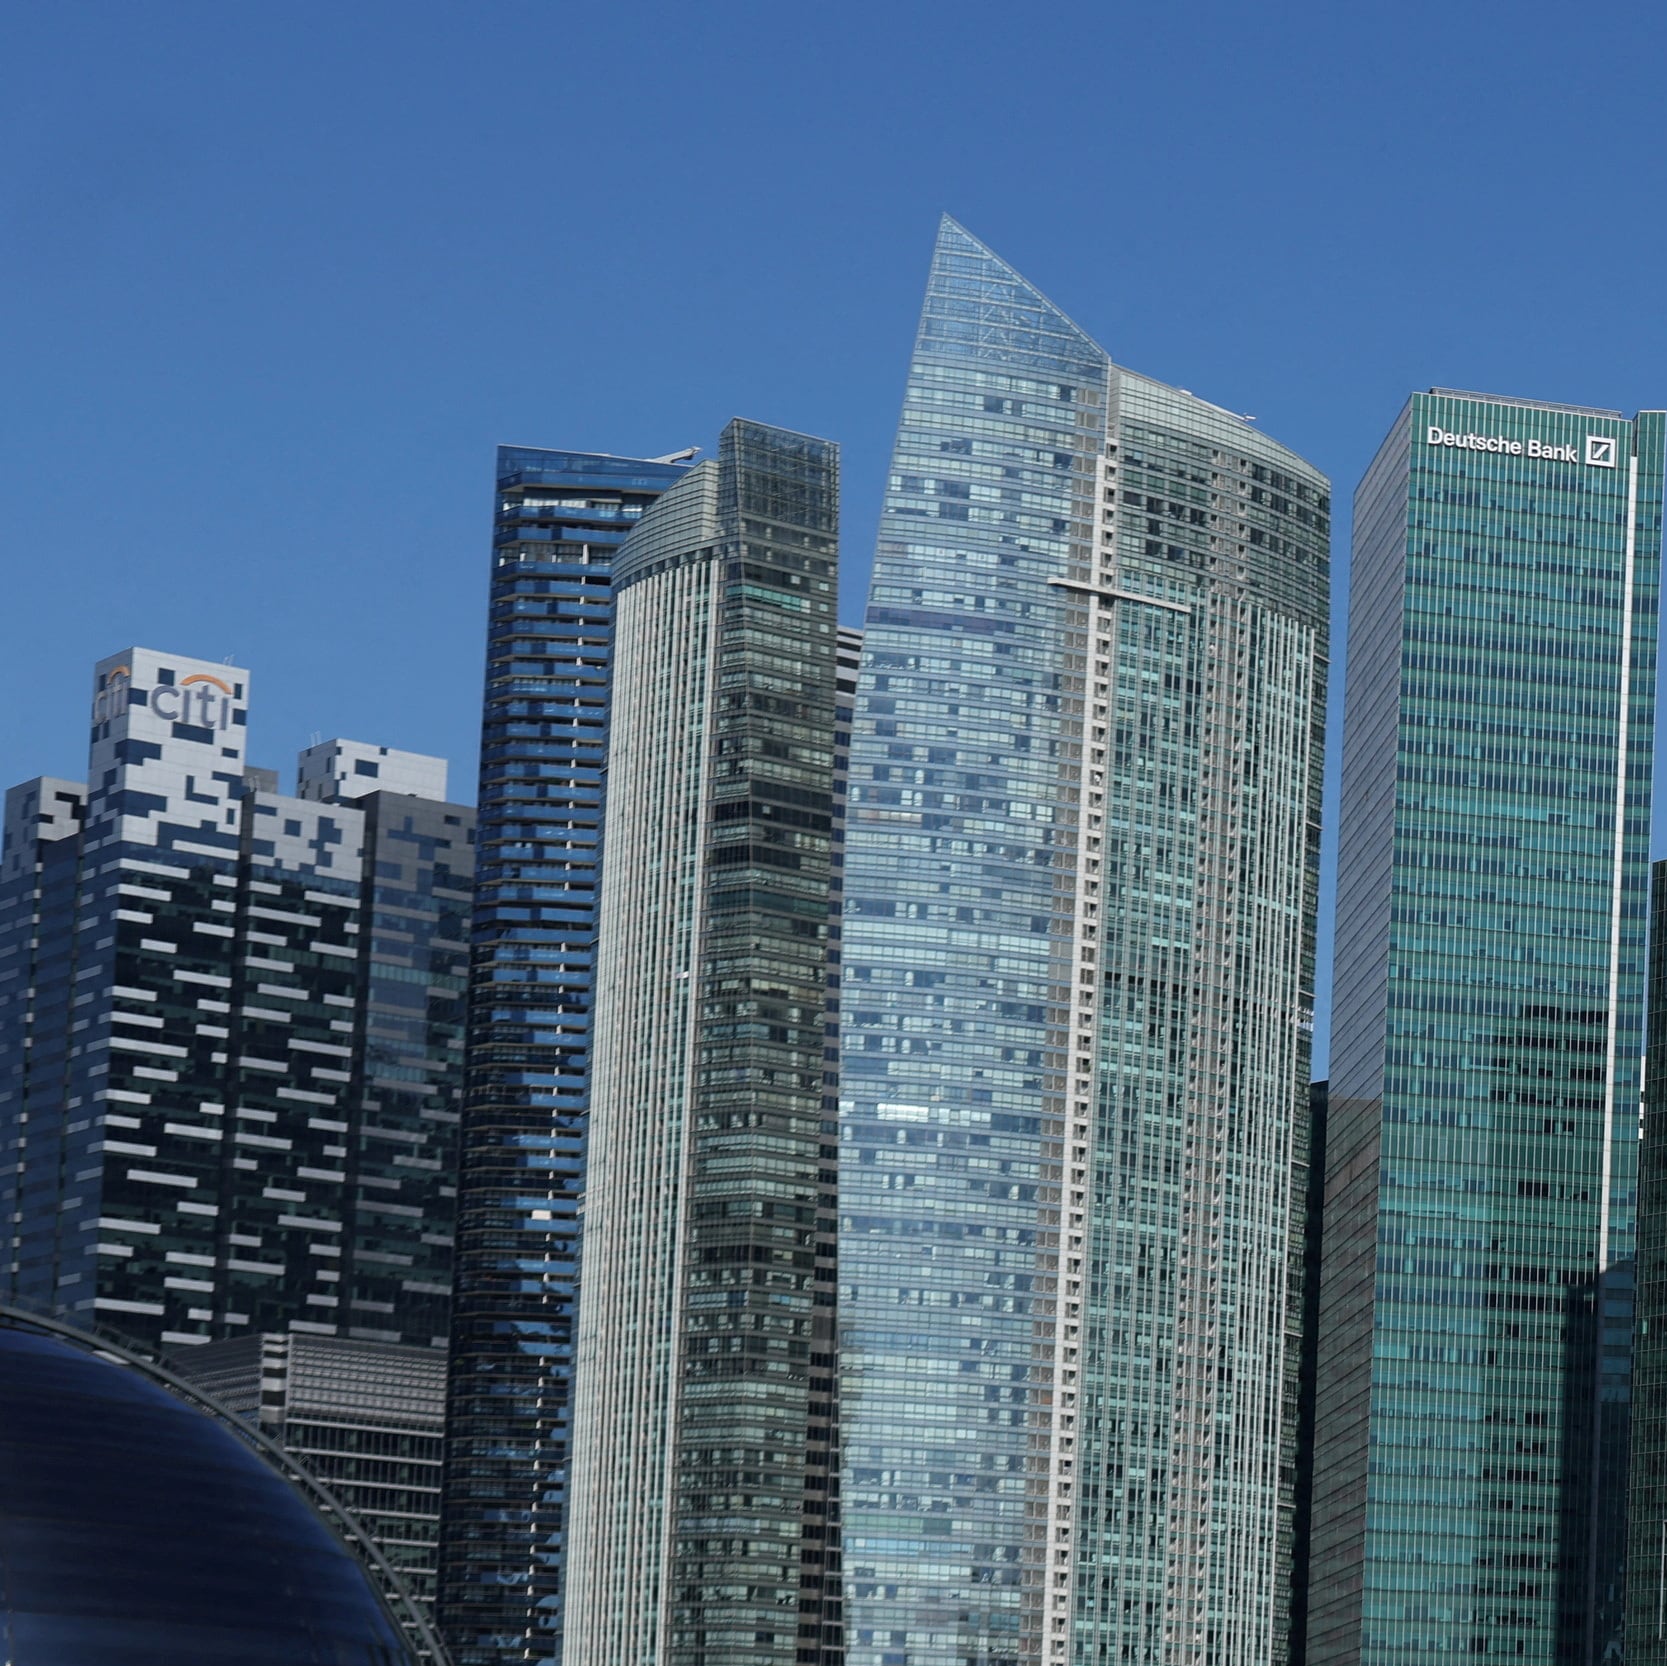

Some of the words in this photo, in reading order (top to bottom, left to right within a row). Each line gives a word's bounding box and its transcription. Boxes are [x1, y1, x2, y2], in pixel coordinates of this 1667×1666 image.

[1427, 426, 1522, 455] Deutsche
[1527, 439, 1578, 463] Bank
[151, 684, 229, 731] citi
